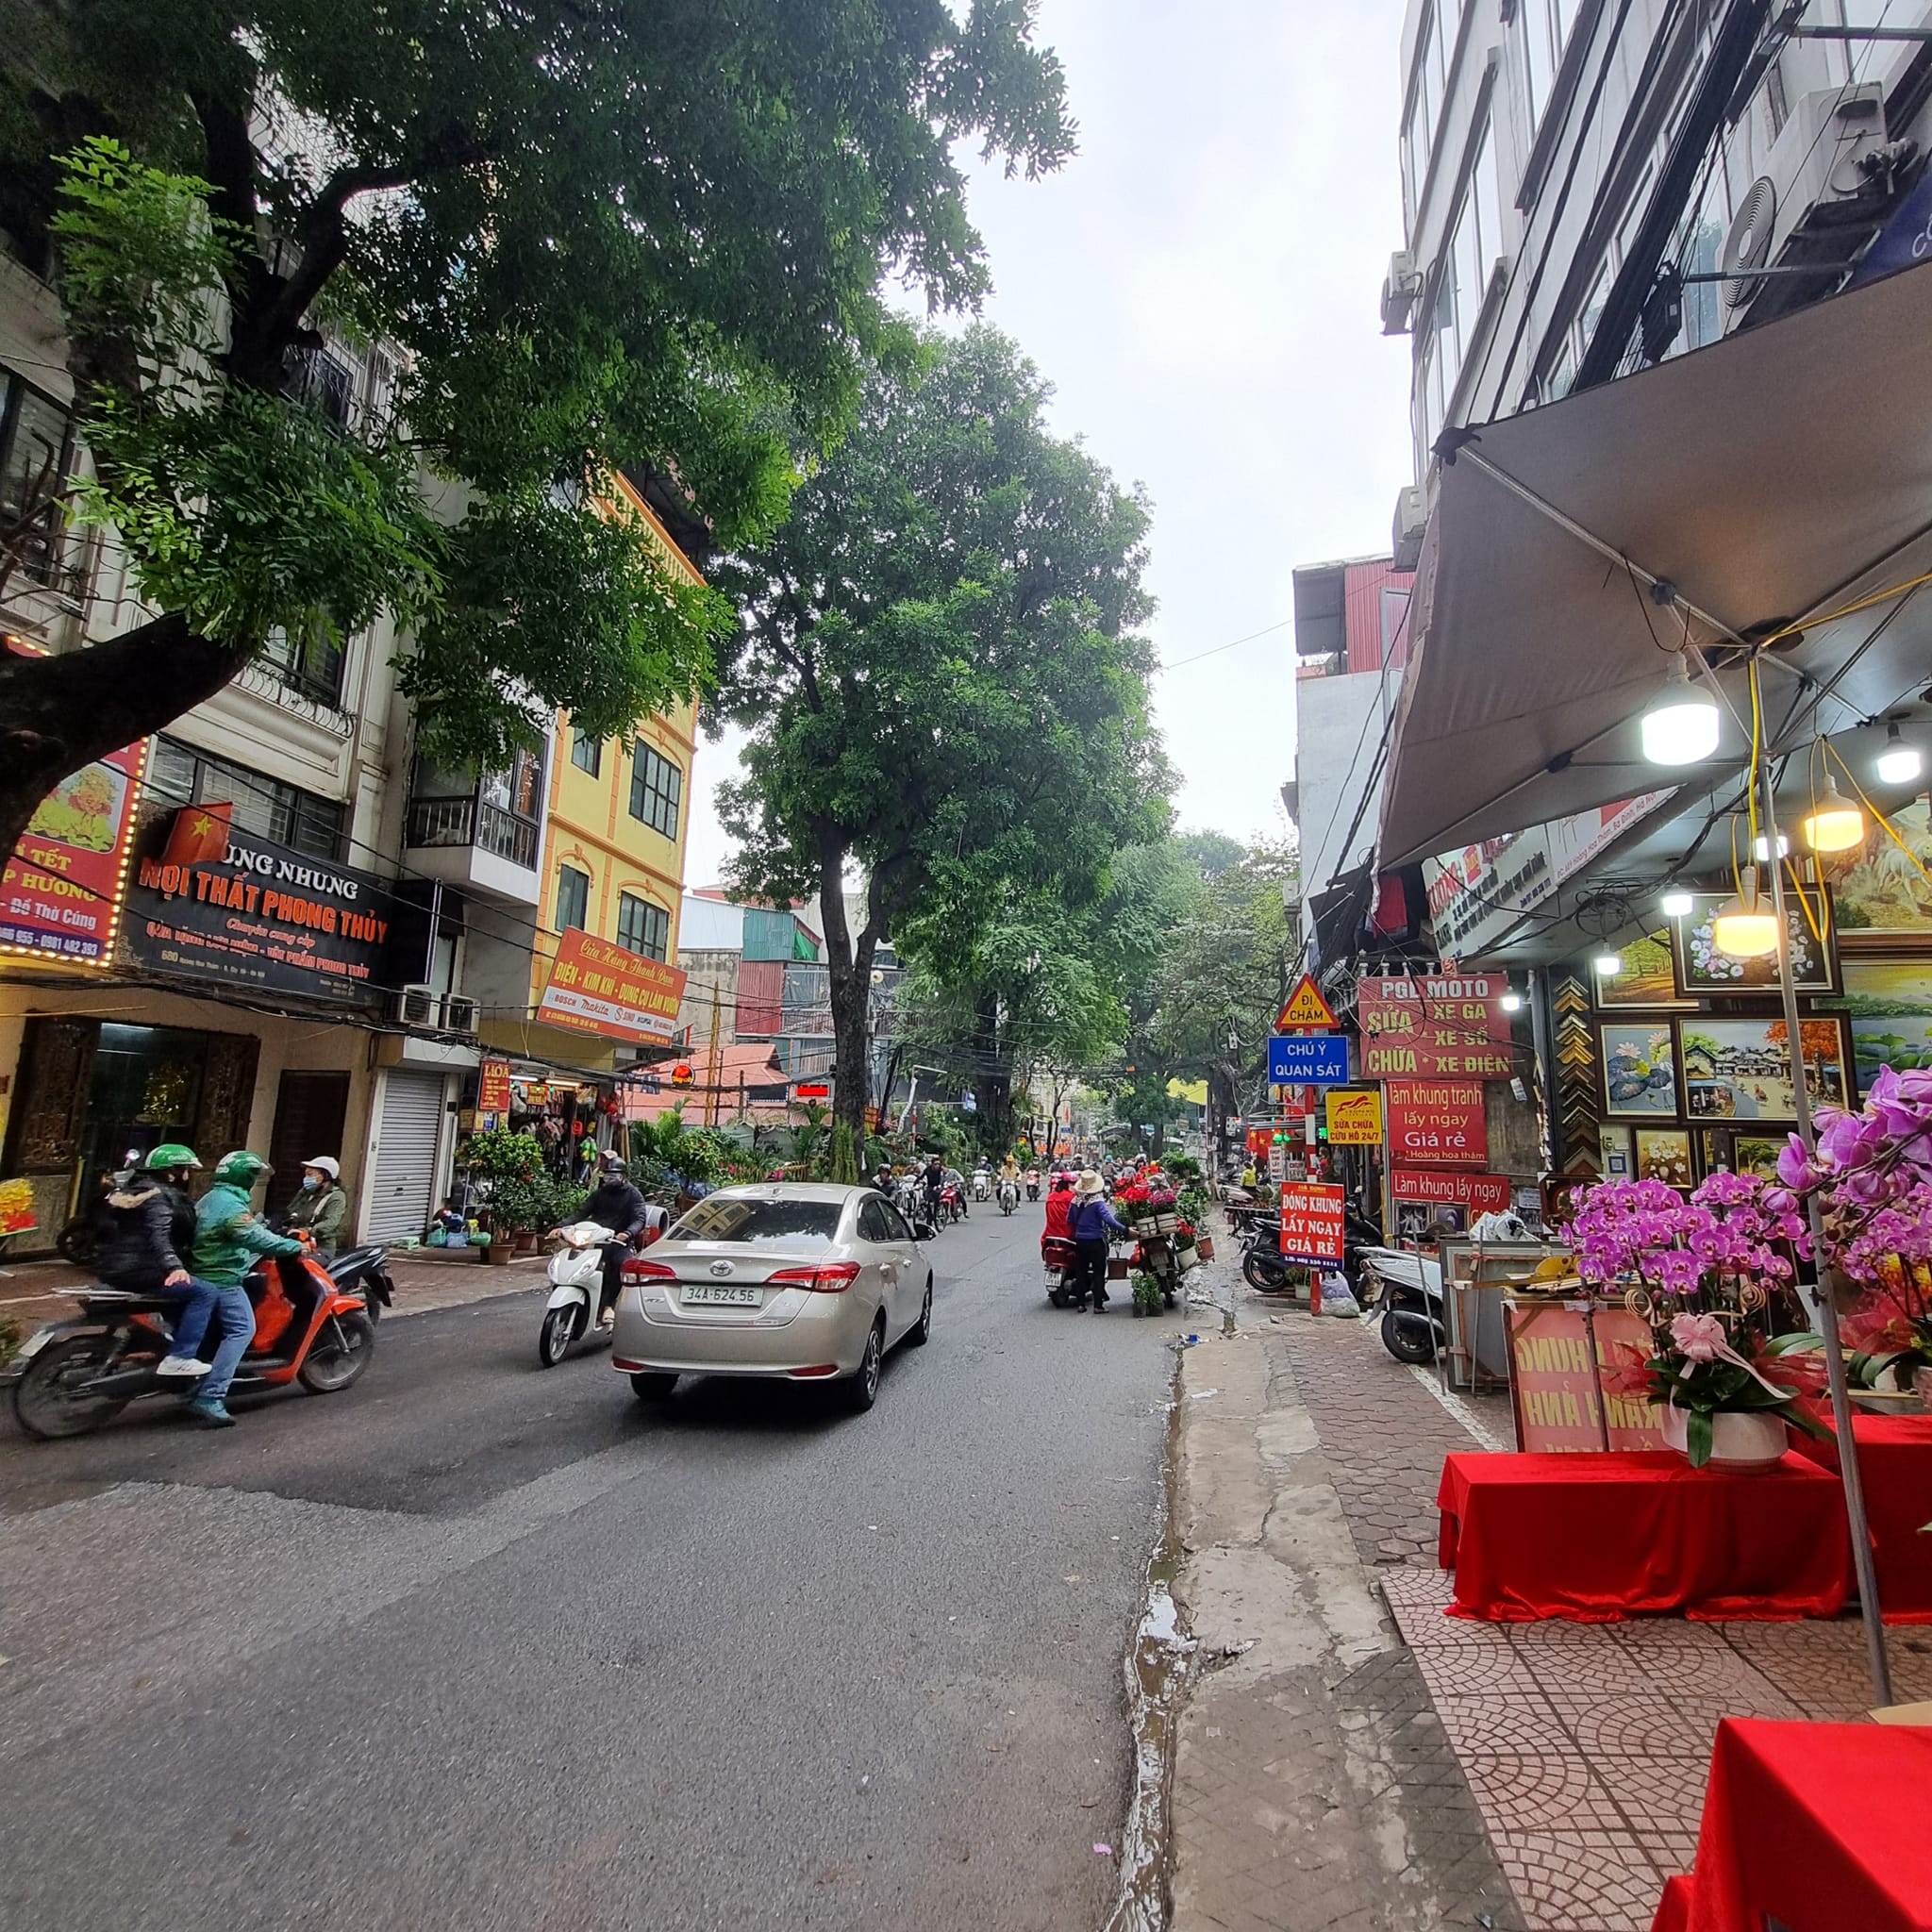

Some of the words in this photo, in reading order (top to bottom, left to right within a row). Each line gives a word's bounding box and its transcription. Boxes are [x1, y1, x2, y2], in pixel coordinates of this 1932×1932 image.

[30, 847, 72, 871] TẾT
[275, 859, 358, 900] NHUNG
[196, 872, 259, 912] THẤT
[262, 889, 336, 933] PHONG
[341, 909, 388, 943] THỦY
[62, 908, 97, 930] Cúng
[582, 971, 602, 991] KIM
[599, 975, 617, 996] KHÍ
[1426, 979, 1489, 998] MOTO
[555, 993, 576, 1007] BOSCH
[1301, 995, 1313, 1007] ĐI
[1290, 1008, 1324, 1023] CHẬM
[1368, 1004, 1414, 1034] SỬA
[1434, 1004, 1456, 1020] XE
[1462, 1003, 1487, 1020] GA
[1435, 1030, 1457, 1045] XE
[1464, 1024, 1488, 1045] SỐ
[1287, 1041, 1315, 1056] CHÚ
[1318, 1041, 1327, 1056] Ý
[1368, 1045, 1417, 1073] CHỮA
[1275, 1065, 1313, 1077] QUAN
[1316, 1062, 1341, 1076] SÁT
[1435, 1057, 1458, 1073] XE
[1465, 1053, 1509, 1075] ĐIỆN
[1390, 1087, 1410, 1105] làm
[1413, 1084, 1449, 1110] khung
[1451, 1086, 1482, 1106] tranh
[1404, 1110, 1425, 1127] lấy
[1430, 1115, 1469, 1127] ngay
[1361, 1132, 1378, 1141] 24/7
[1405, 1132, 1439, 1147] Giá
[1445, 1131, 1466, 1147] rẻ
[1410, 1150, 1440, 1160] Hoàng
[1441, 1150, 1458, 1159] hoa
[1394, 1174, 1417, 1193] Làm
[1420, 1175, 1454, 1201] khung
[1457, 1176, 1473, 1201] lấy
[1474, 1184, 1502, 1203] ngay
[1283, 1191, 1307, 1211] ĐÓNG
[1309, 1197, 1341, 1214] KHUNG
[1282, 1212, 1305, 1232] LẤY
[1307, 1221, 1341, 1236] NGAY
[1287, 1236, 1312, 1253] GIÁ
[1317, 1237, 1336, 1255] RẺ
